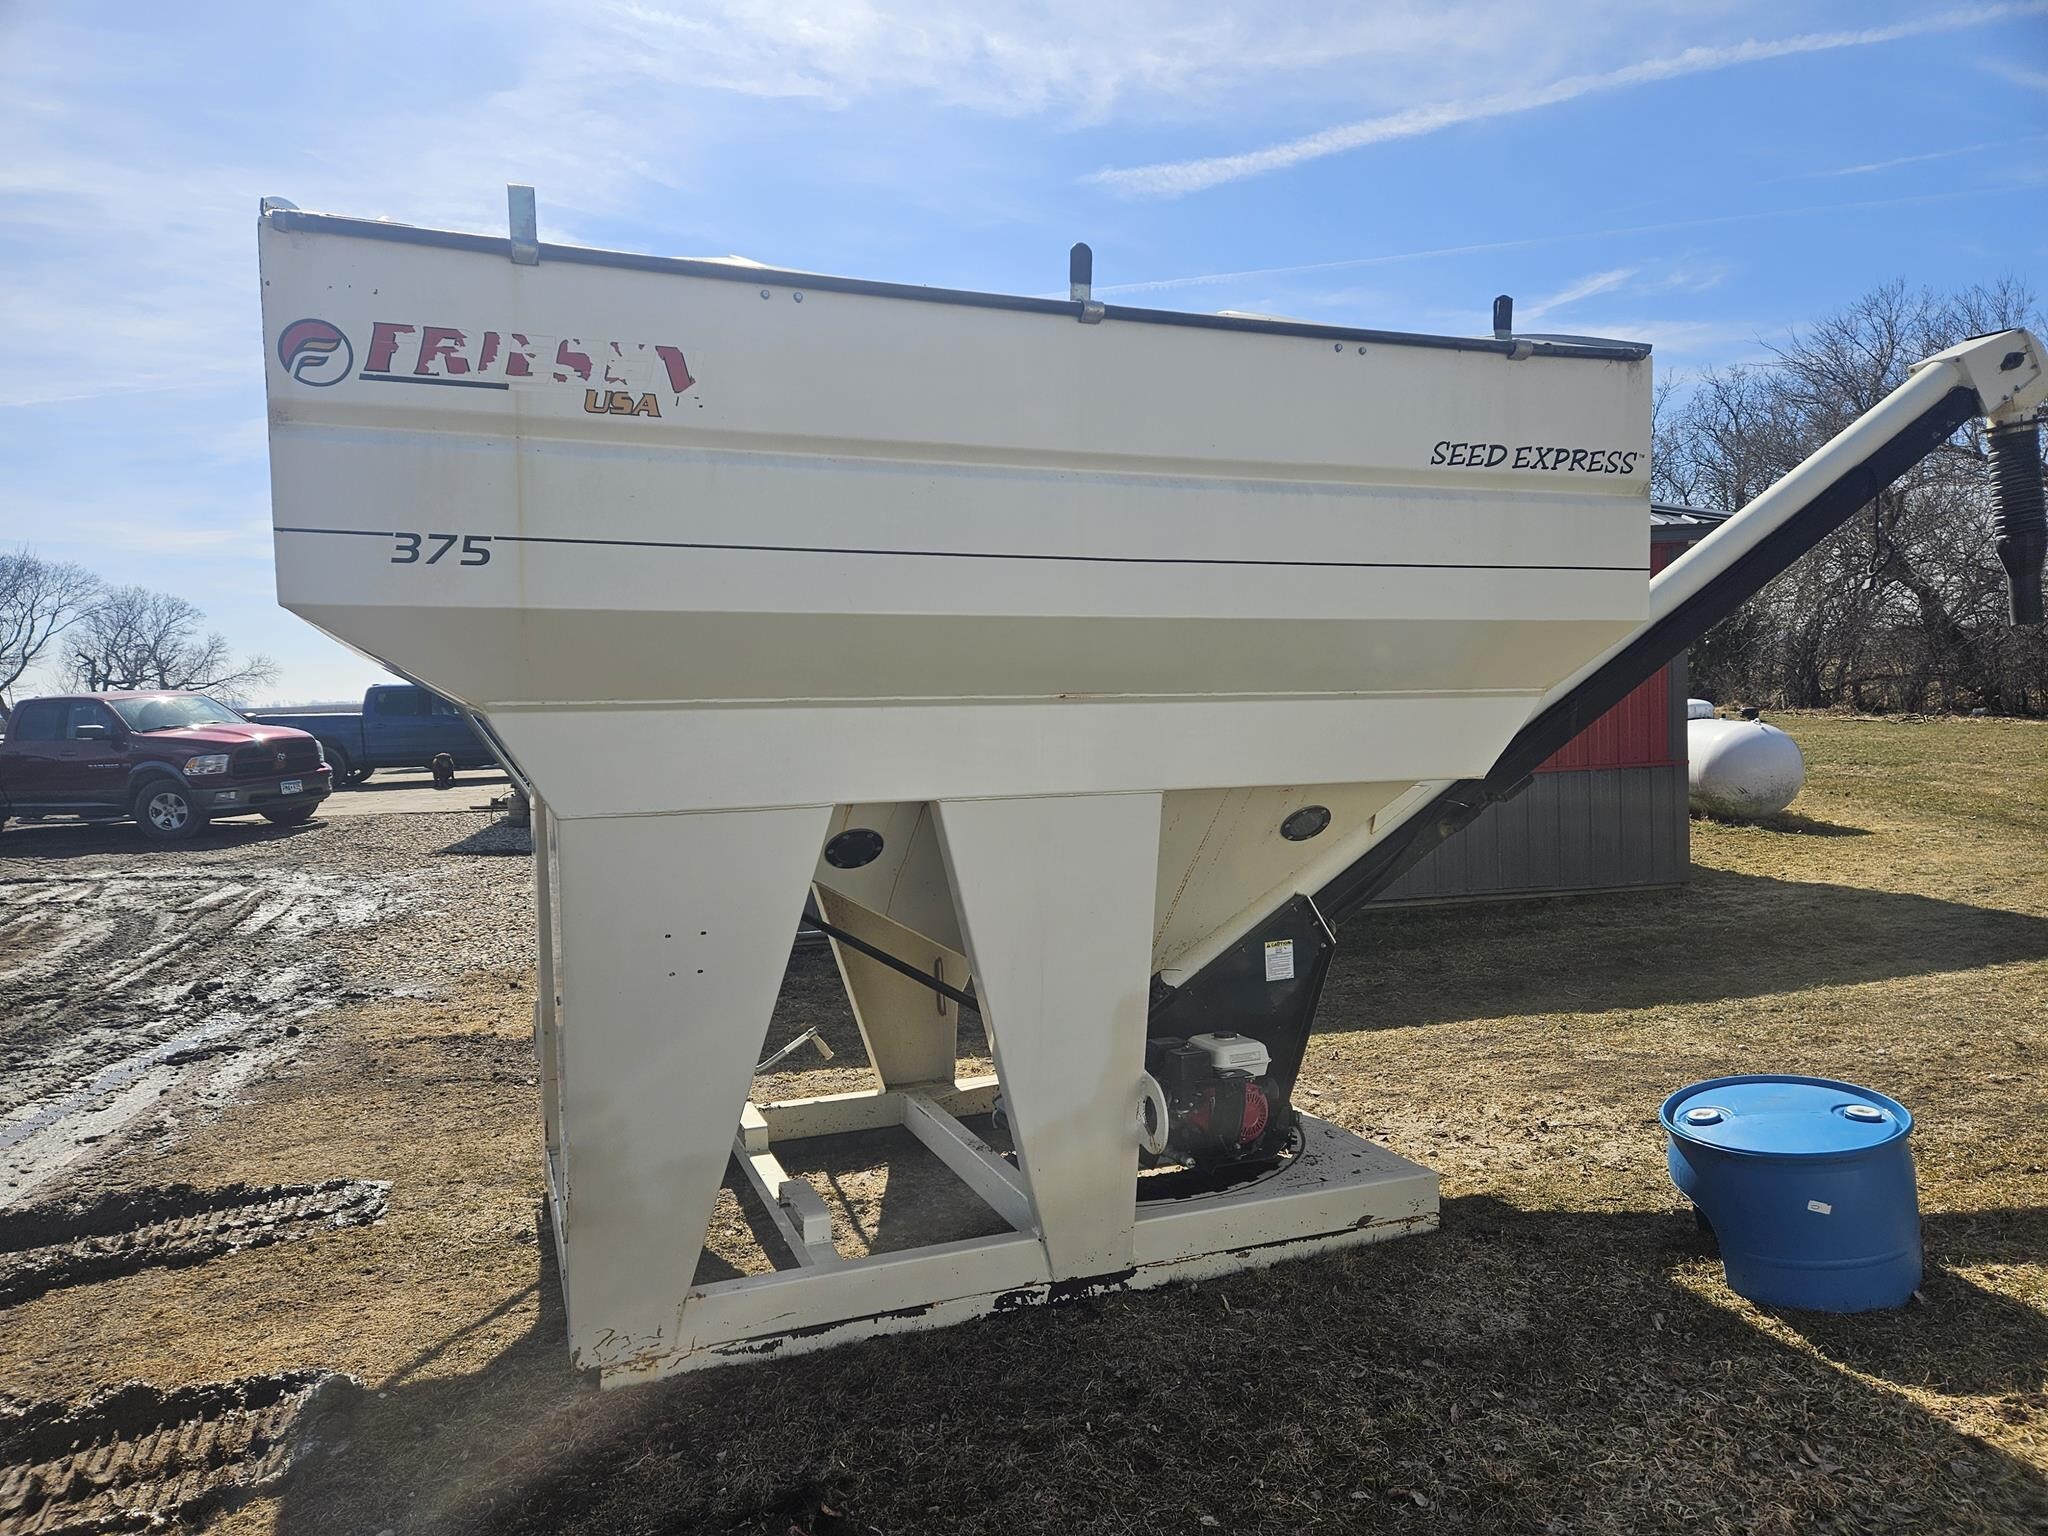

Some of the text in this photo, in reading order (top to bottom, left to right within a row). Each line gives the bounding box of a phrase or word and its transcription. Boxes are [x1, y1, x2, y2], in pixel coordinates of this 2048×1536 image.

[363, 321, 697, 394] FRIES
[583, 388, 662, 418] USA
[1430, 440, 1508, 468] SEED
[390, 531, 492, 566] 375
